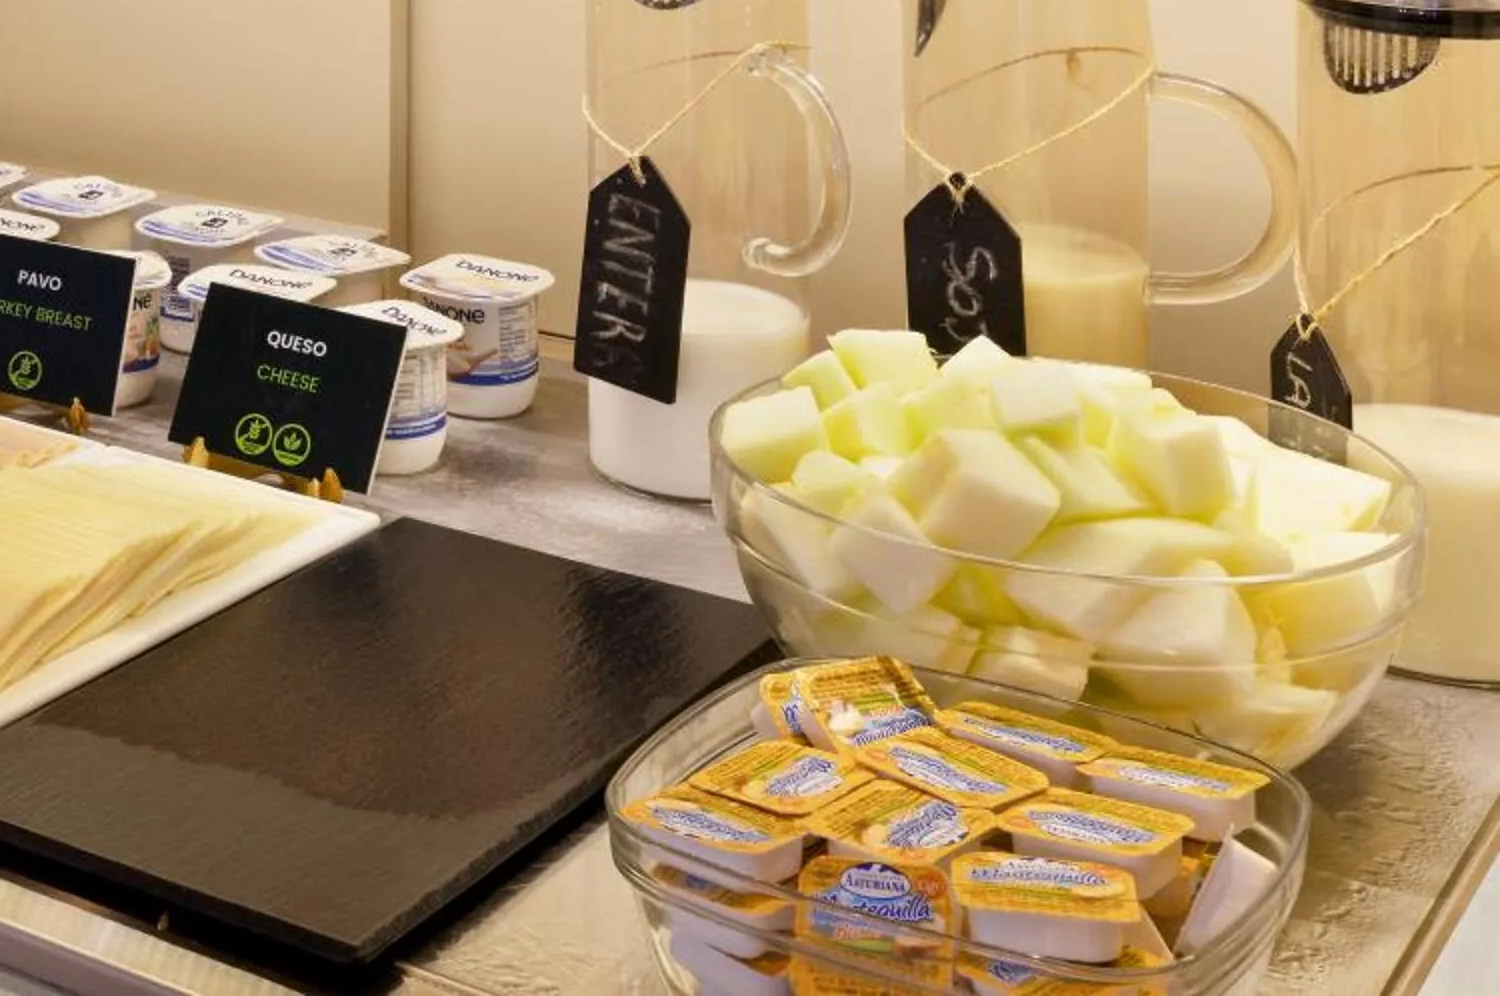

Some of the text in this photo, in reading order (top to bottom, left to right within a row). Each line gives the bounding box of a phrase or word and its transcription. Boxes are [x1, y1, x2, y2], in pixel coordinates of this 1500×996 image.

[17, 268, 63, 291] PAVO
[35, 306, 94, 332] BREAST
[266, 329, 328, 357] QUESO
[257, 364, 321, 394] CHEESE
